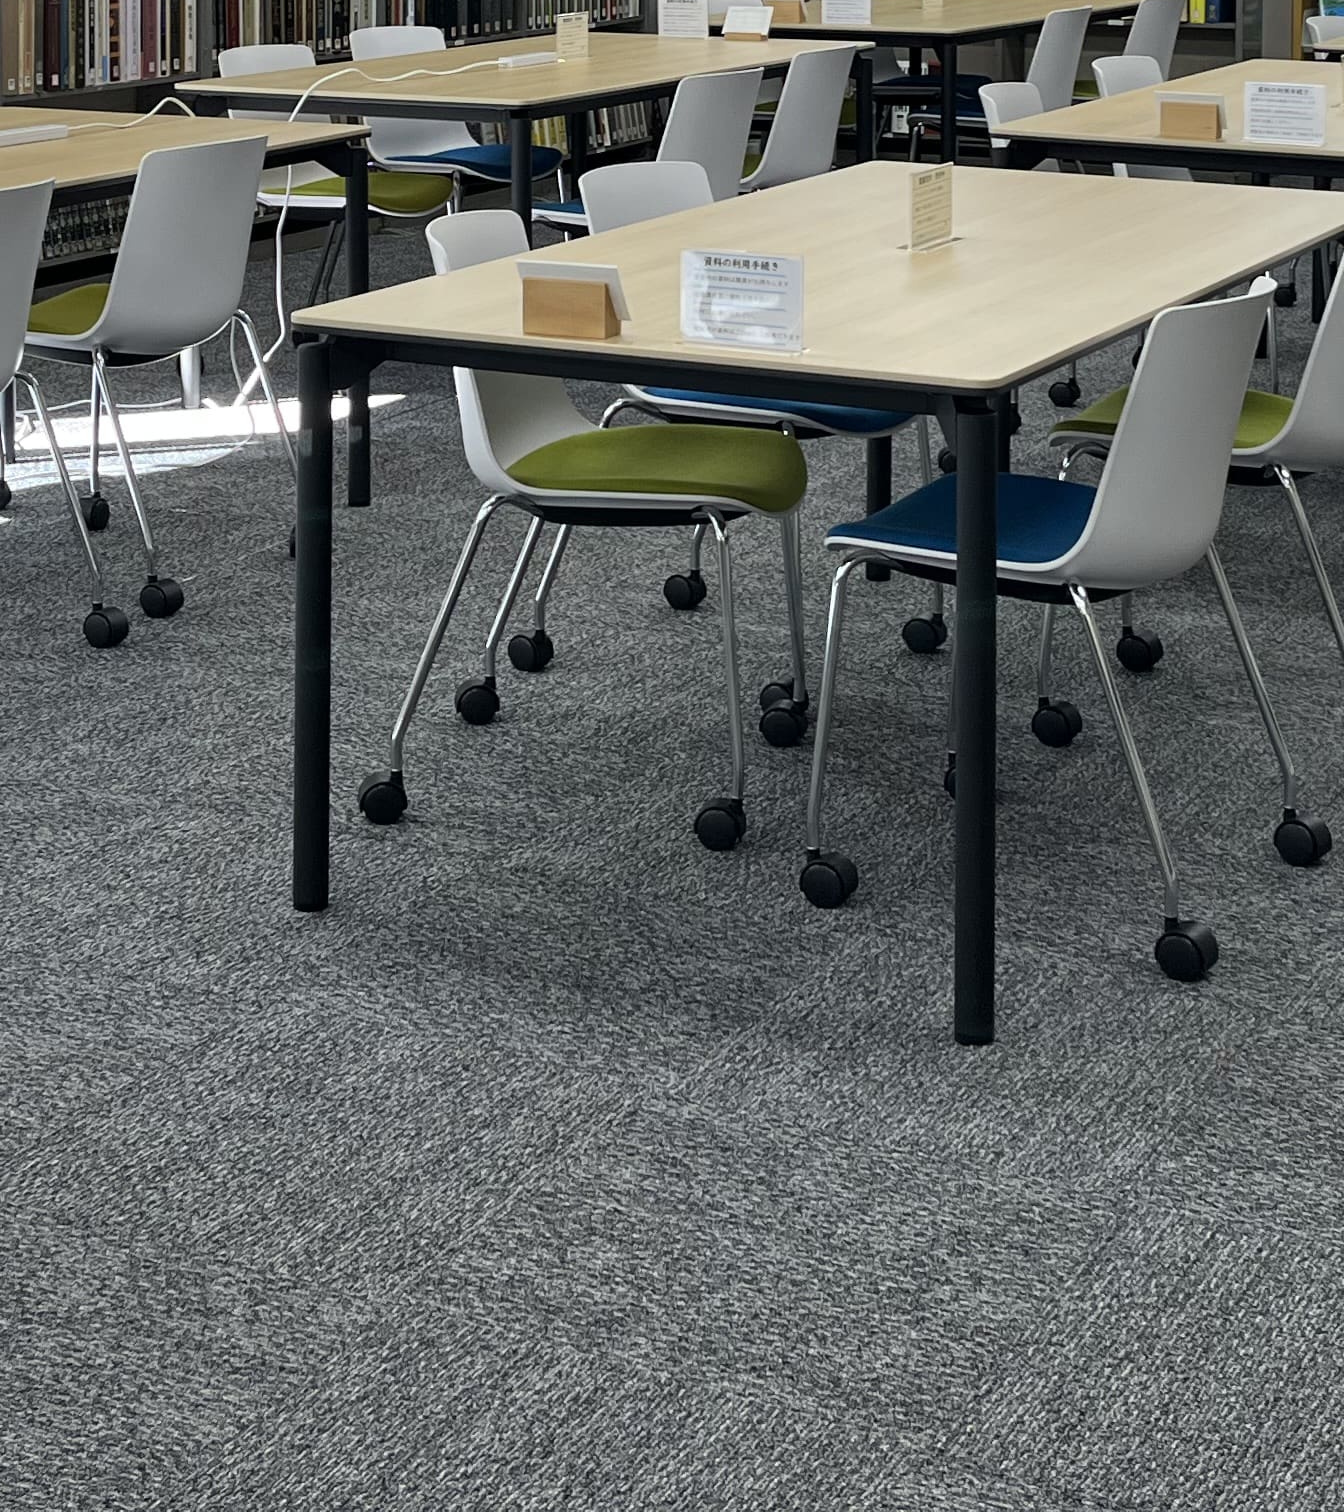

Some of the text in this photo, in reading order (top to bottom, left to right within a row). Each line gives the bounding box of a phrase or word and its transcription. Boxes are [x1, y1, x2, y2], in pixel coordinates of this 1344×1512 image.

[703, 256, 779, 272] 資料の利用手続き
